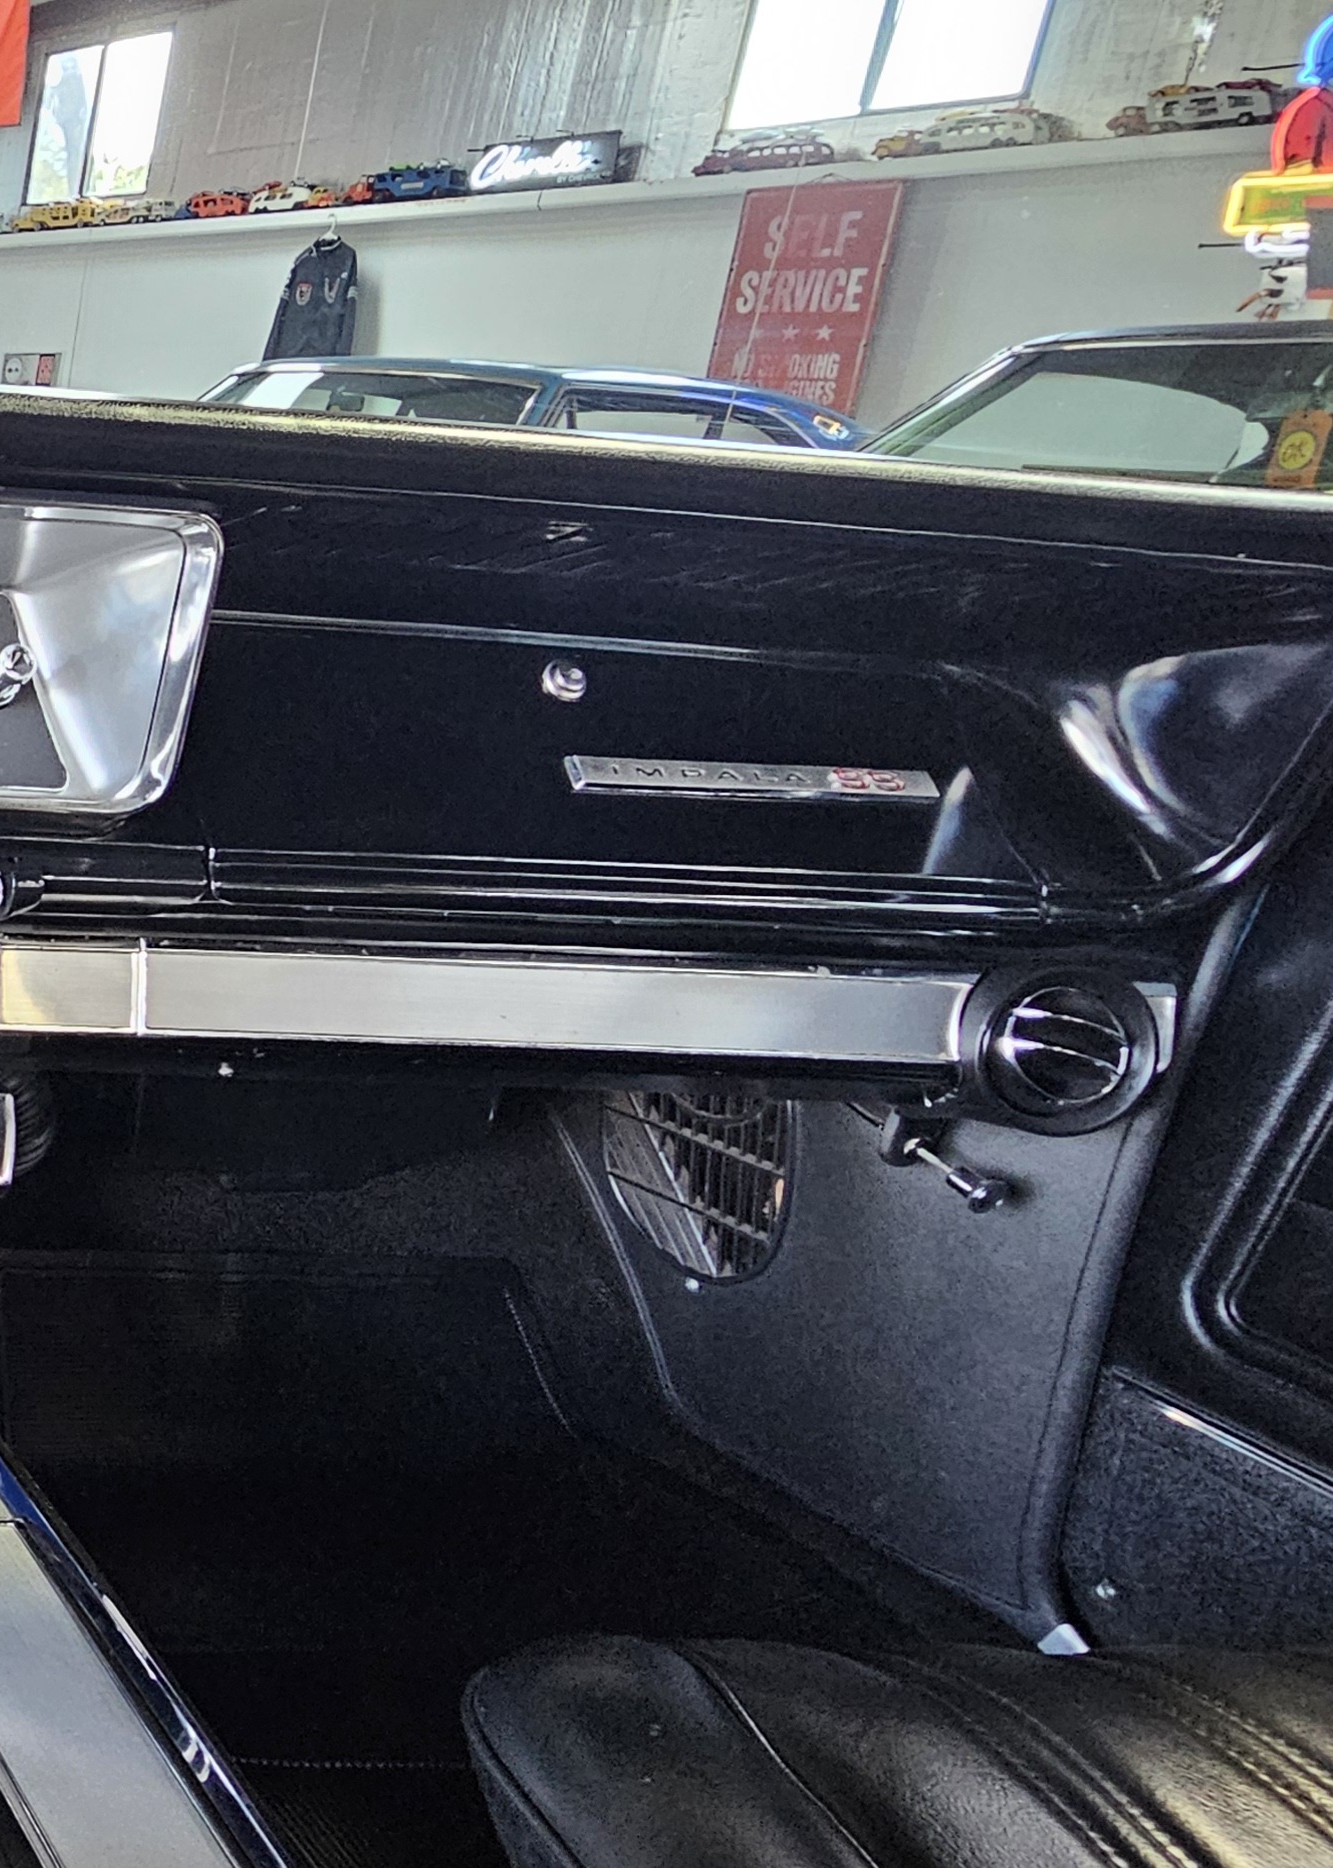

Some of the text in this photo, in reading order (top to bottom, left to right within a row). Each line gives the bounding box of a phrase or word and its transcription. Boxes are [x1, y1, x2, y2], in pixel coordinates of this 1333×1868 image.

[763, 210, 864, 260] SELF
[735, 267, 870, 315] SERVICE
[610, 765, 906, 790] IMPALA SS
